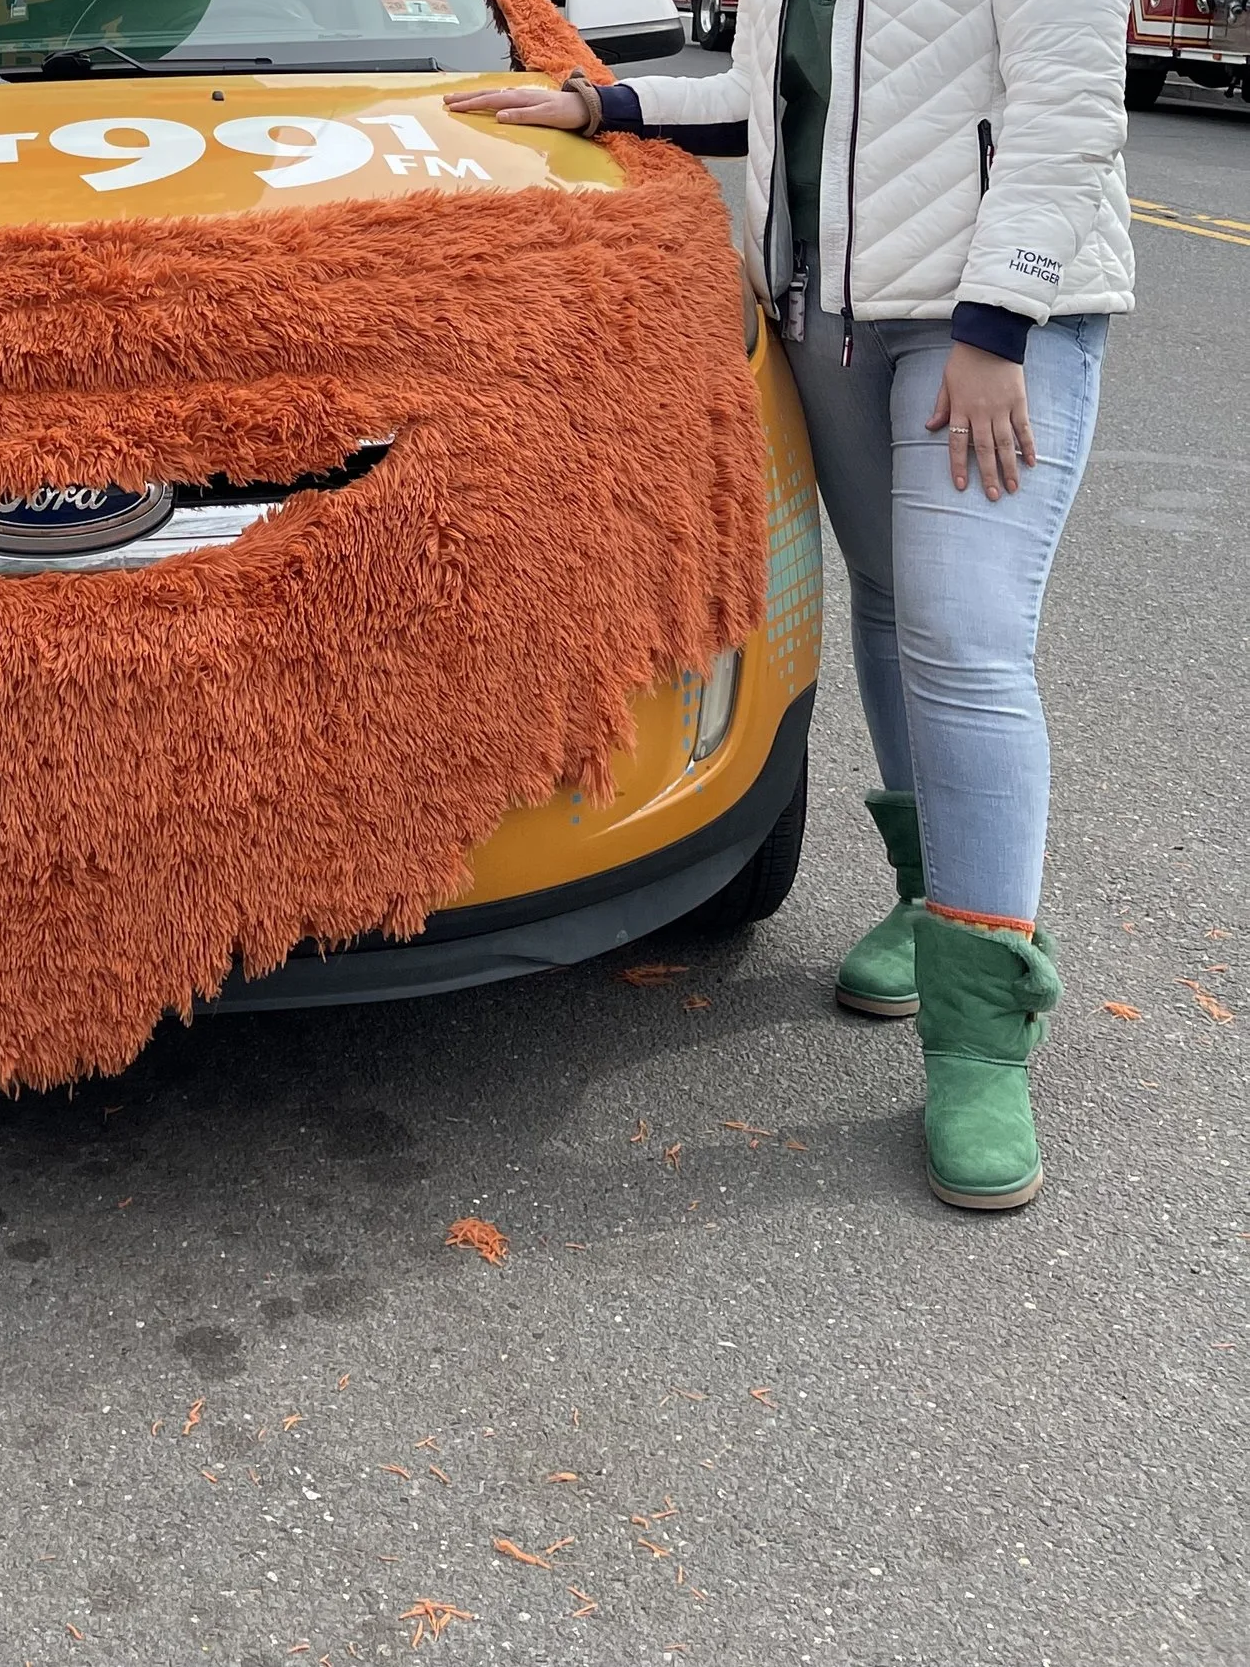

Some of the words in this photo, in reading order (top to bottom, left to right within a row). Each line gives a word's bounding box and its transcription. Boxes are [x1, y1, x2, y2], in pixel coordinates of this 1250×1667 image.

[382, 153, 493, 182] FM
[1009, 259, 1060, 286] HILFIGER
[1016, 248, 1063, 272] TOMMY
